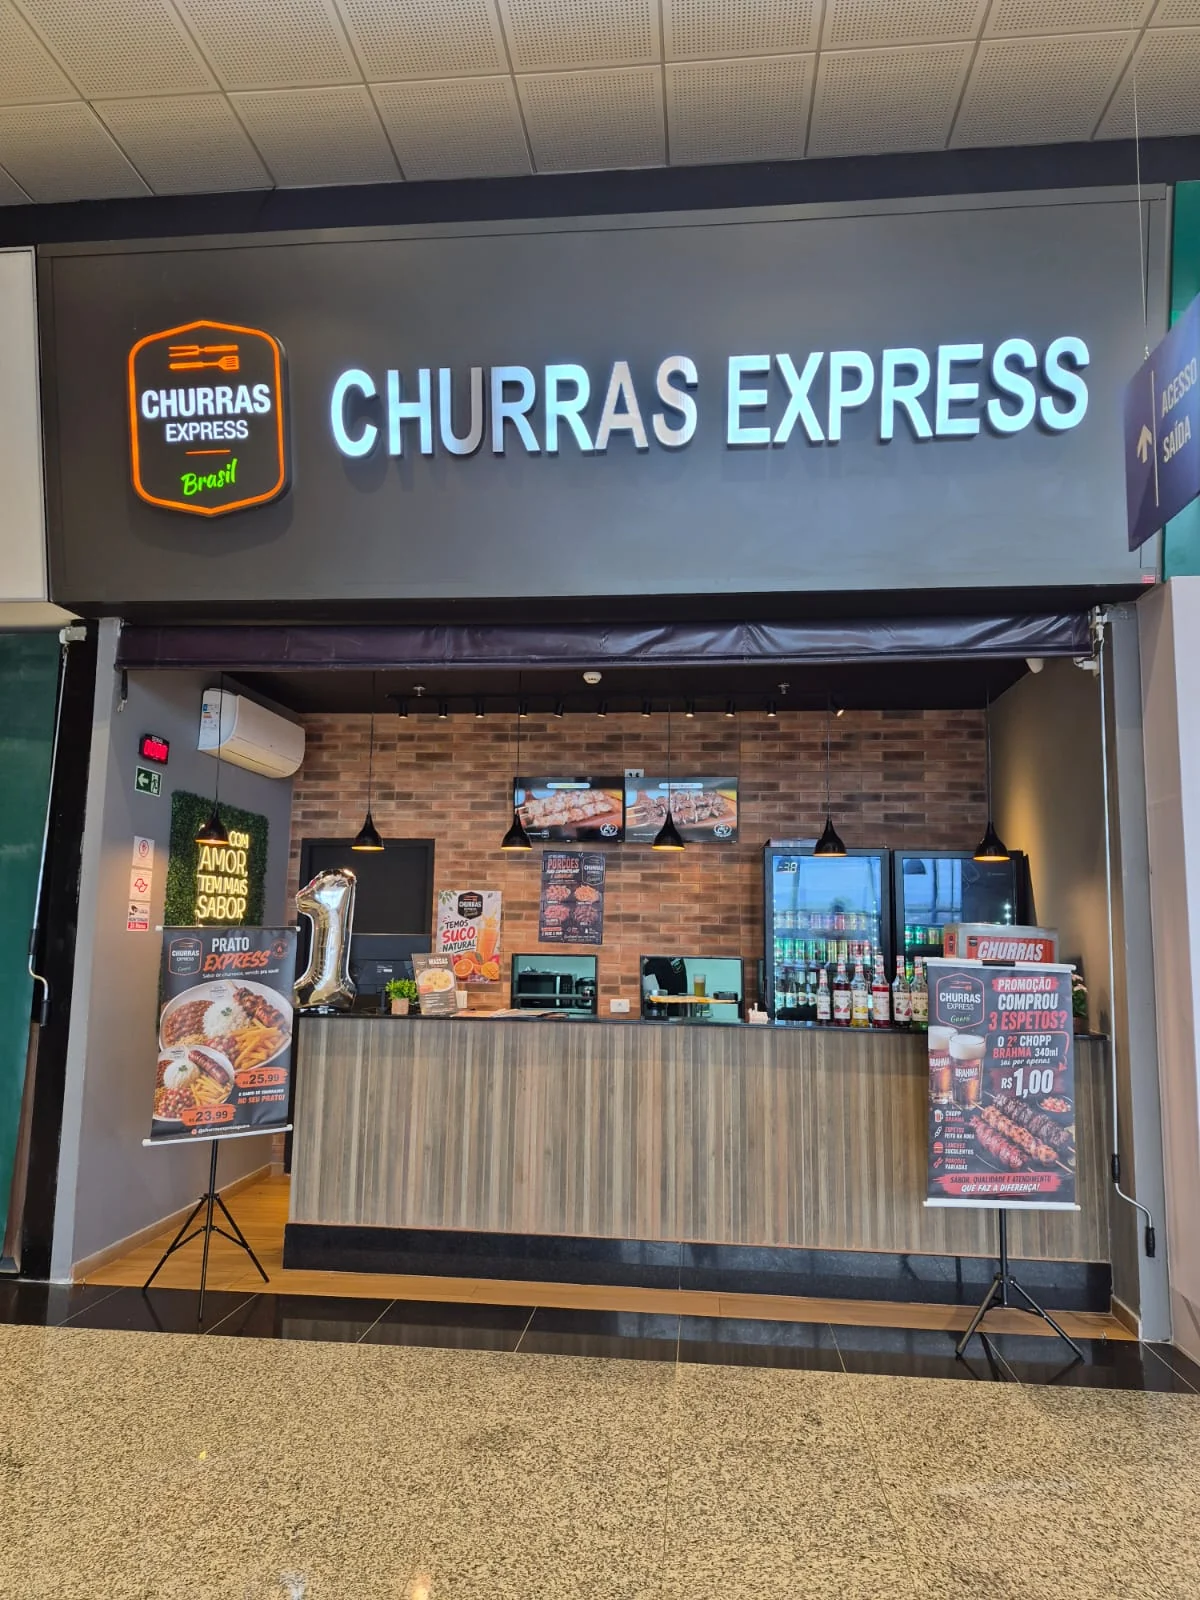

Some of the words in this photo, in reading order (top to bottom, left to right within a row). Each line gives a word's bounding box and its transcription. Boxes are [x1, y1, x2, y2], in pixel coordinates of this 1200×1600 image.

[330, 356, 698, 457] CHURRAS
[727, 336, 1090, 447] EXPRESS
[1162, 357, 1197, 418] ACESSO
[141, 383, 271, 418] CHURRAS
[165, 420, 249, 443] EXPRESS
[1163, 415, 1192, 463] SAÍDA
[181, 457, 238, 496] Brasil
[228, 830, 249, 848] COM
[197, 874, 222, 894] TEM
[224, 878, 248, 896] MAIS
[195, 896, 246, 919] SABOR
[445, 920, 469, 929] TEMOS
[442, 926, 476, 944] SUCO
[211, 937, 250, 952] PRATO
[442, 941, 477, 952] NATURAL
[977, 940, 1044, 961] CHURRAS
[202, 950, 271, 972] EXPRESS
[997, 976, 1051, 993] PROMOÇÃO
[939, 992, 981, 1004] CHURRAS
[946, 1003, 975, 1011] EXPRESS
[997, 993, 1059, 1011] COMPROU
[988, 1011, 998, 1031] 3
[1001, 1010, 1068, 1031] ESPETOS?
[997, 1035, 1005, 1047] O
[1019, 1035, 1052, 1047] CHOPP
[992, 1047, 1032, 1058] BRAHMA
[1034, 1047, 1058, 1057] 340ml
[1011, 1059, 1025, 1068] por
[1025, 1057, 1050, 1066] apenas
[249, 1074, 280, 1085] 25,99
[955, 1067, 979, 1078] BRAHMA
[1001, 1077, 1013, 1090] R$
[1013, 1067, 1054, 1098] 1,00
[261, 1094, 286, 1102] PRATO!
[961, 1184, 976, 1192] QUE
[977, 1184, 992, 1192] FAZ
[999, 1183, 1040, 1193] DIFERENÇA!
